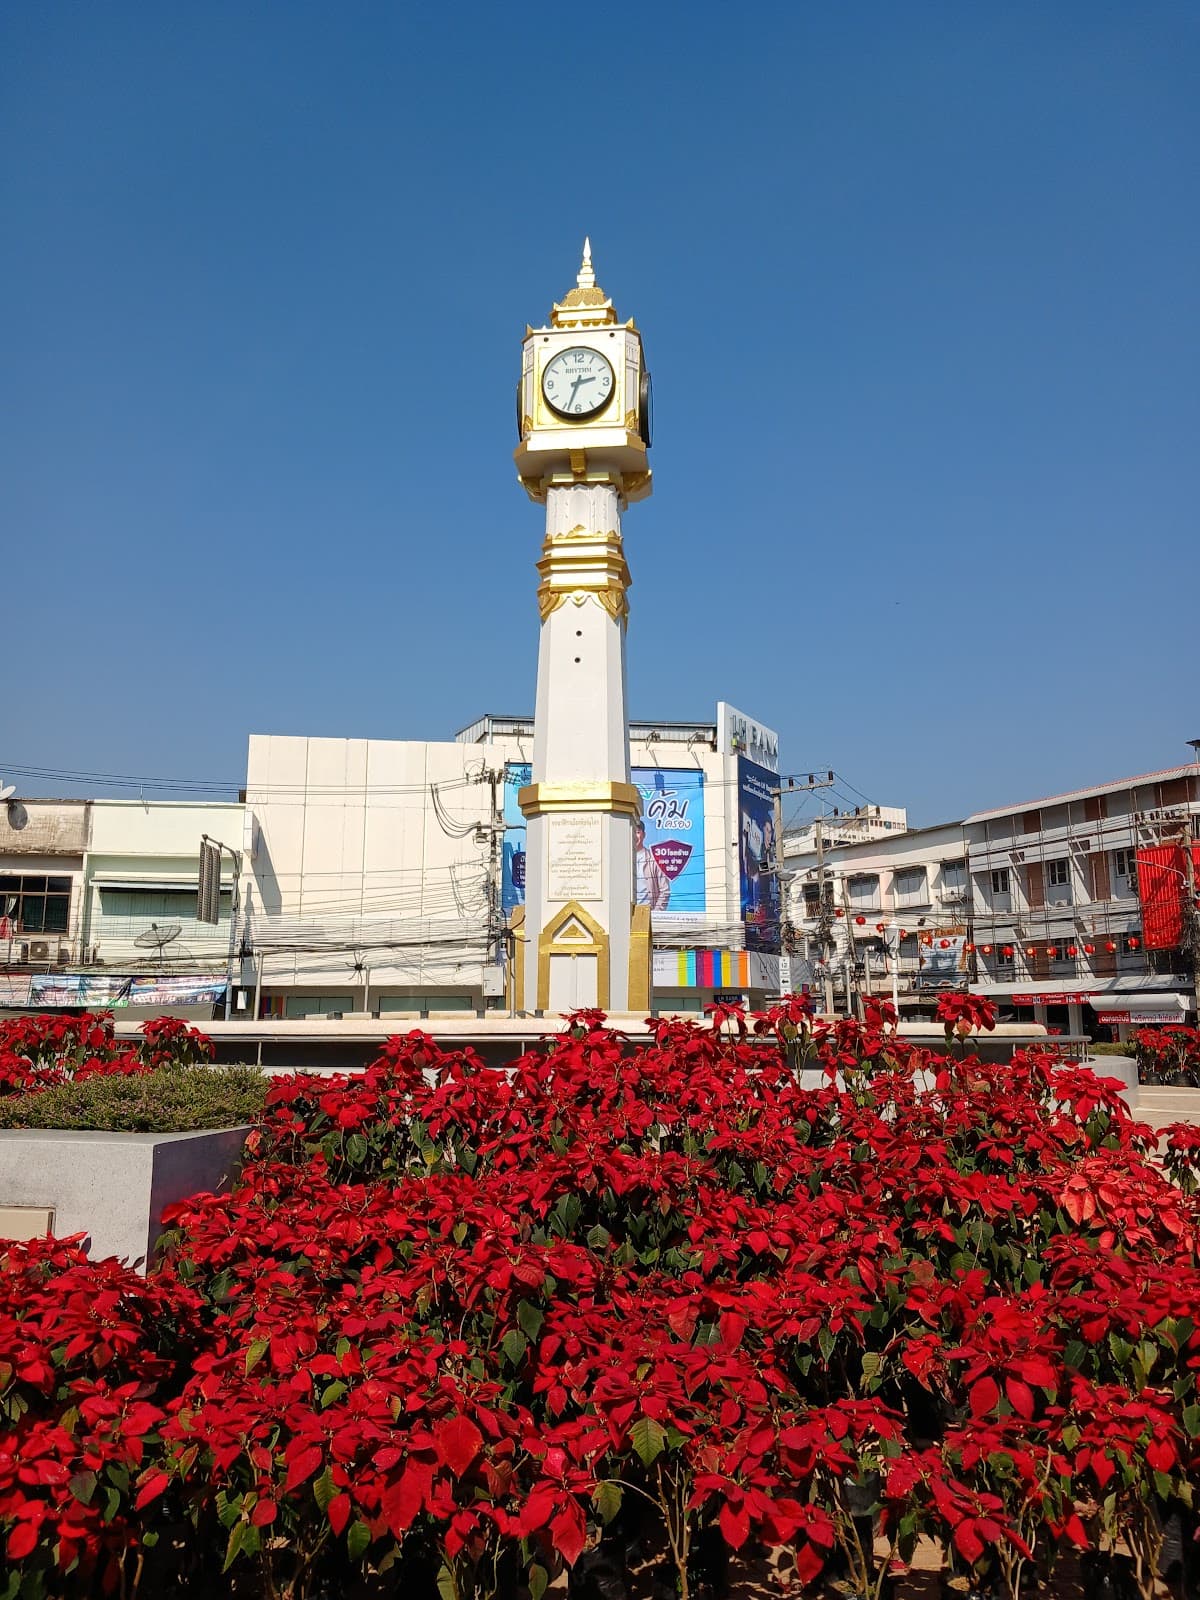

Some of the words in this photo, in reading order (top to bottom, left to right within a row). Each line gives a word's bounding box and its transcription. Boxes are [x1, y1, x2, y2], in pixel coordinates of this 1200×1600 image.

[573, 353, 585, 364] 12
[547, 380, 554, 389] 9
[602, 377, 610, 386] 3
[574, 404, 582, 413] 6
[750, 724, 778, 758] BANK
[648, 790, 689, 828] คุ้ม
[654, 848, 667, 857] 30
